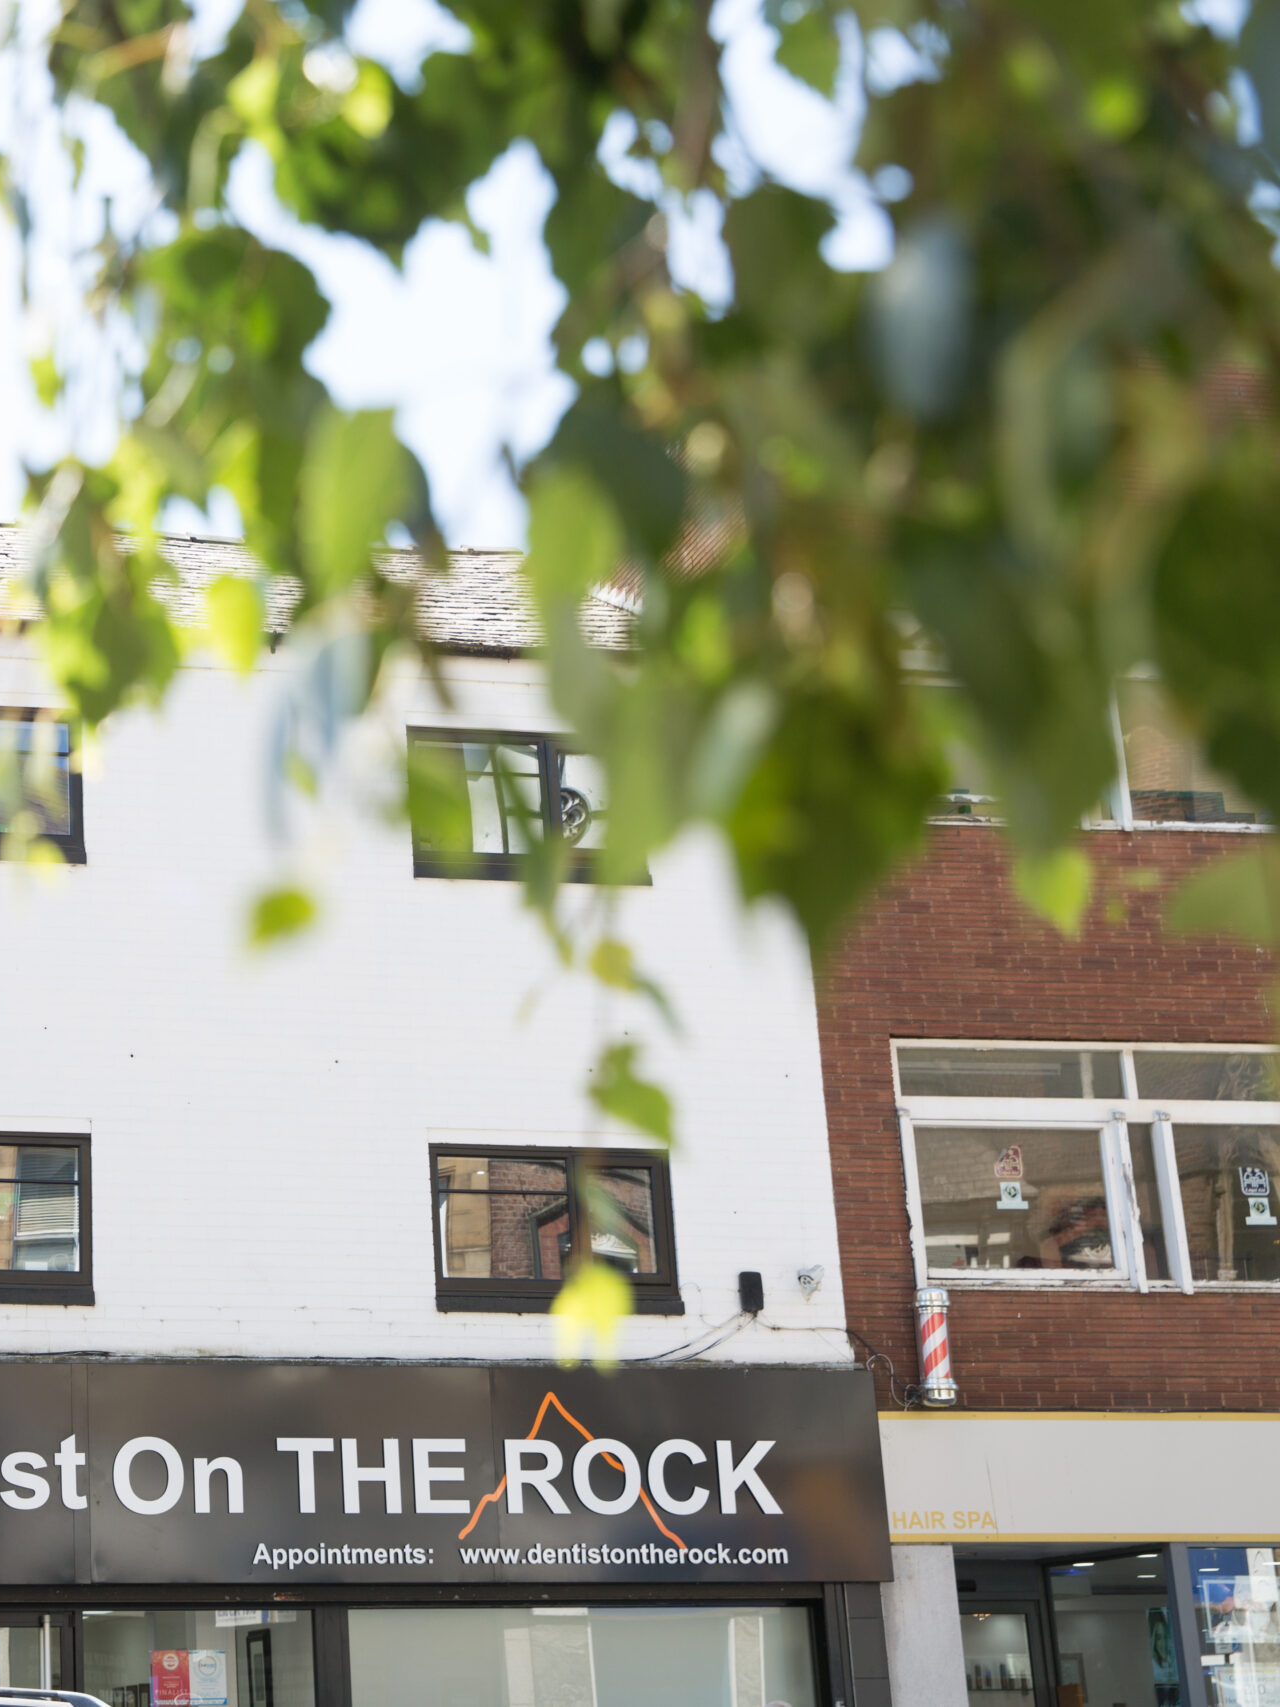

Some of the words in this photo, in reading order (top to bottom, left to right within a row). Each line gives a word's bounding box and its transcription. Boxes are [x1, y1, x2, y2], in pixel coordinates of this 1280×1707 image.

[112, 1436, 245, 1516] On
[276, 1437, 471, 1515] THE
[503, 1438, 784, 1517] ROCK
[892, 1511, 947, 1530] HAIR
[952, 1511, 997, 1530] SPA
[252, 1542, 434, 1571] Appointments:
[459, 1542, 789, 1566] www.dentistontherock.com
